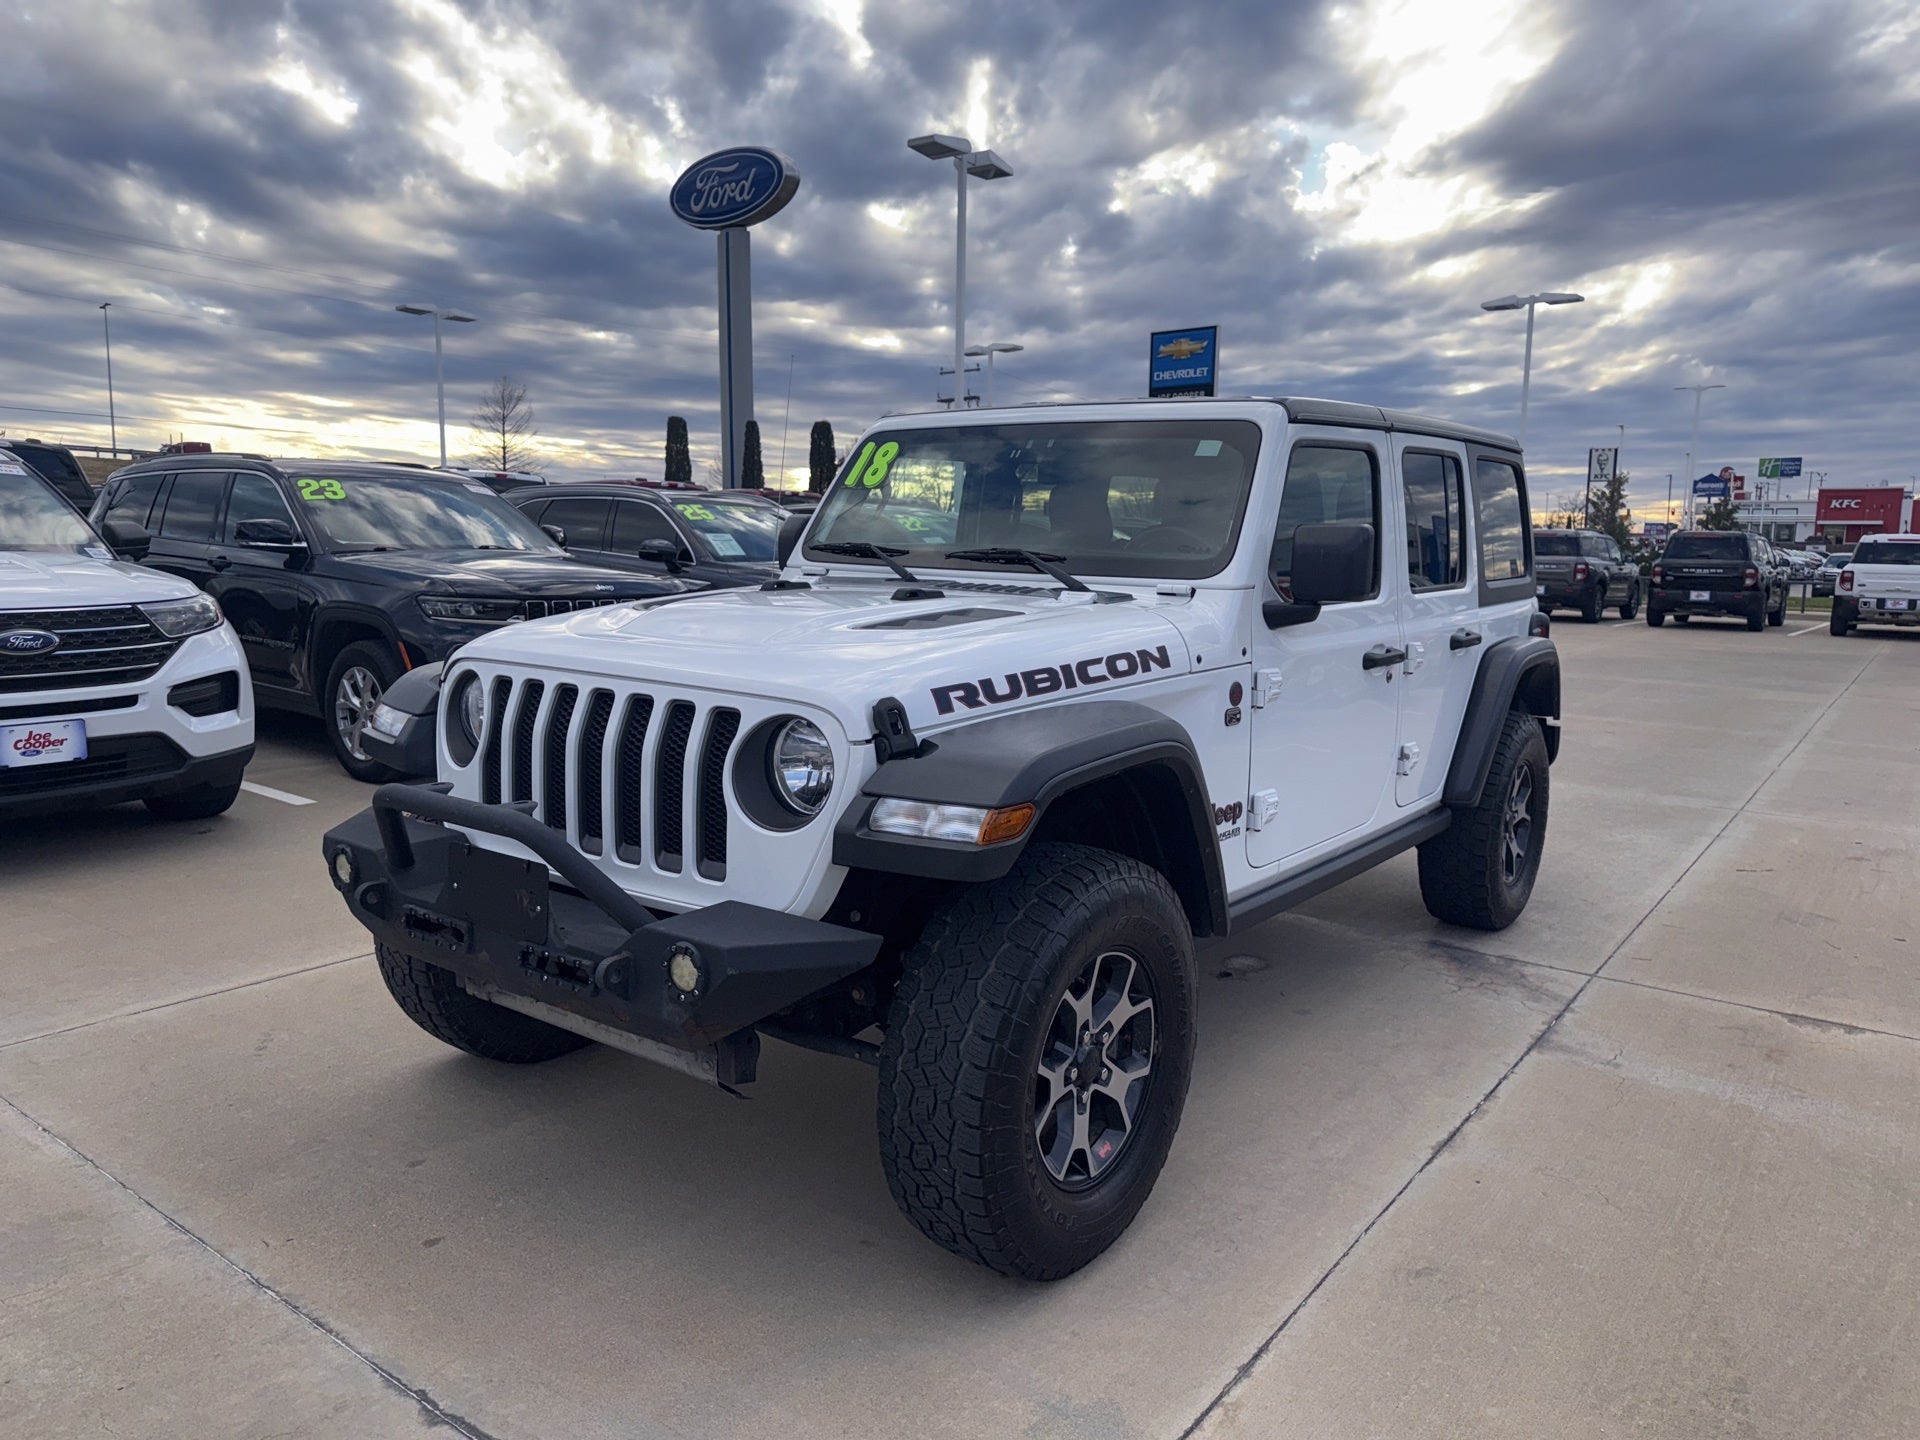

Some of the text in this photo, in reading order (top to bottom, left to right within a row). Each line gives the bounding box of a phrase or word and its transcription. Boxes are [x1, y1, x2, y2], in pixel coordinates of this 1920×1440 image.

[690, 162, 756, 212] Ford
[1153, 367, 1208, 381] CHEVROLET
[844, 442, 900, 488] 18
[297, 479, 346, 500] 23
[1829, 499, 1862, 509] KFC
[677, 504, 716, 521] 25
[595, 584, 615, 592] Jeep
[7, 635, 44, 649] Ford
[930, 645, 1171, 715] RUBICON
[24, 731, 52, 742] Joe
[13, 738, 68, 751] Cooper
[1216, 827, 1240, 840] NGLER
